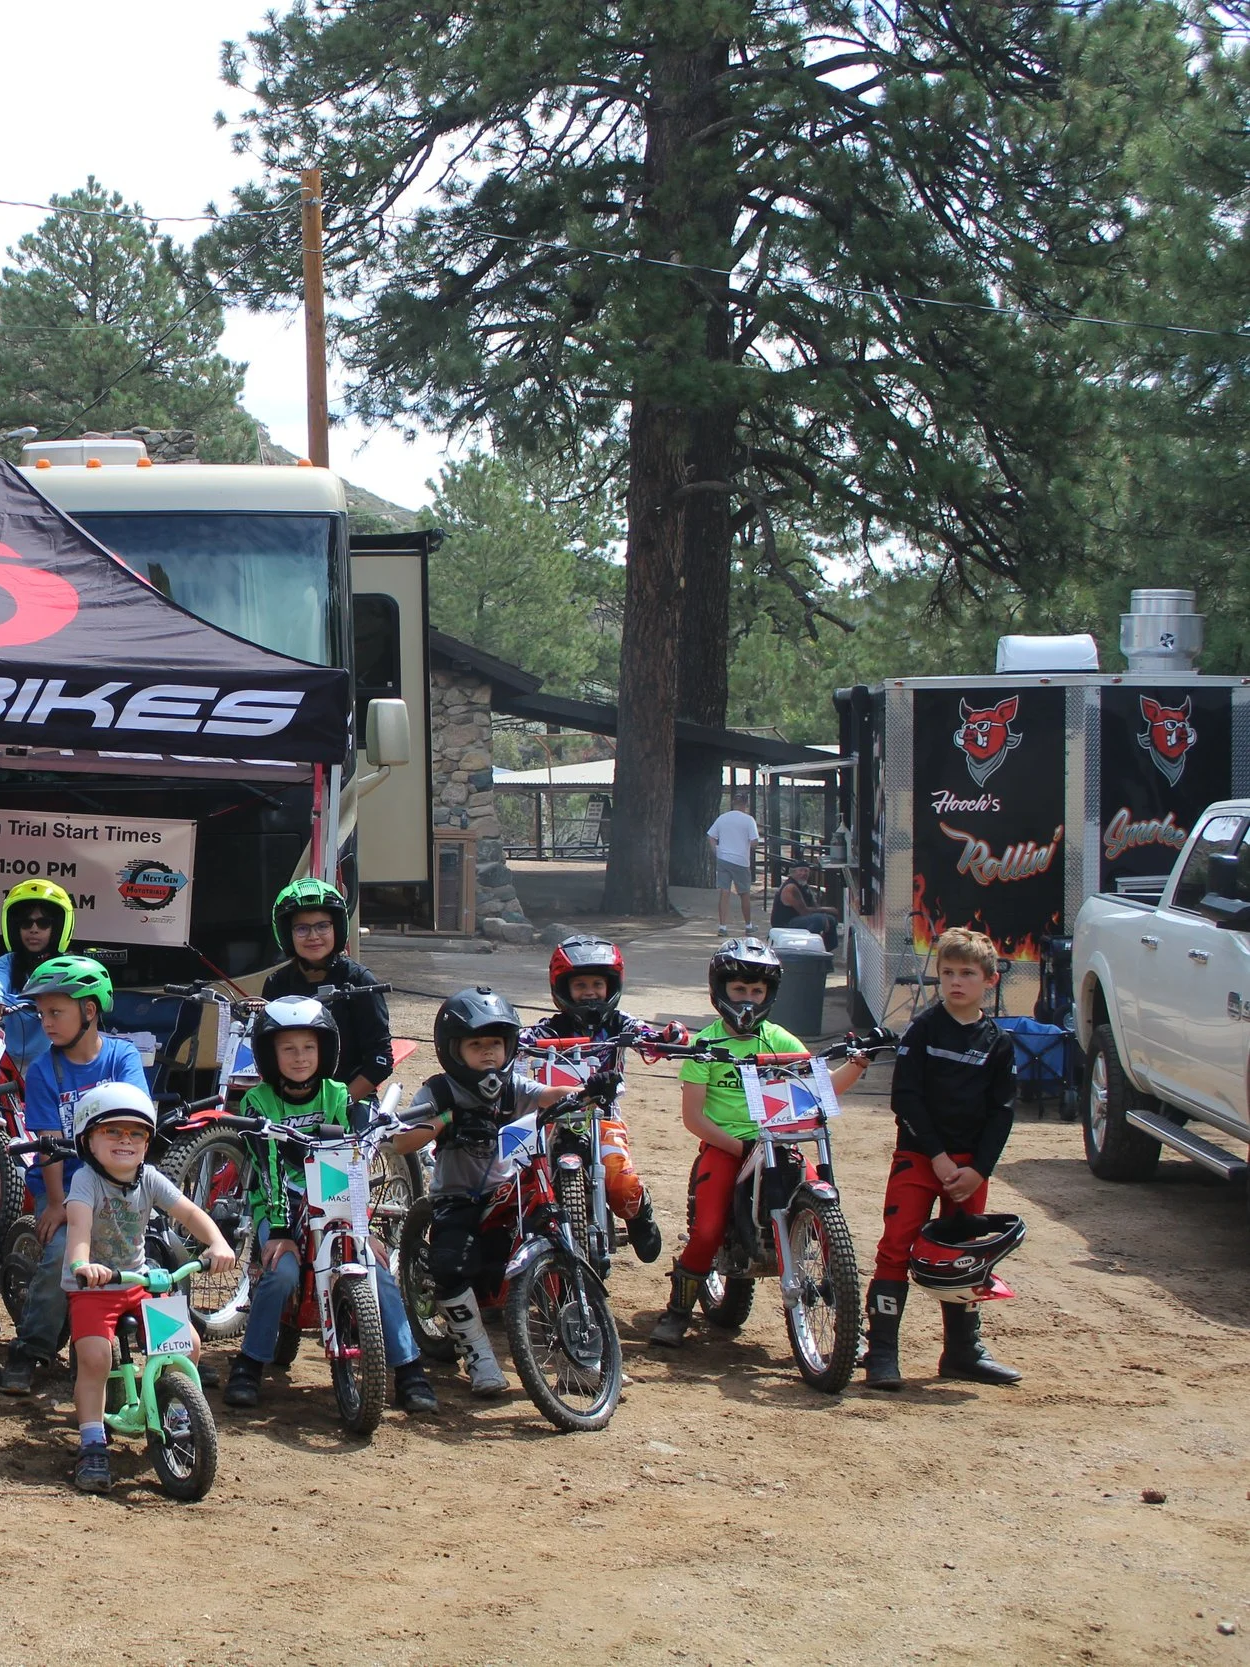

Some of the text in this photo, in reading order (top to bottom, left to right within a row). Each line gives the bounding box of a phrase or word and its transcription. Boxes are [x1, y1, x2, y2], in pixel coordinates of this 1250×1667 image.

[931, 789, 1001, 814] Hooch's
[7, 819, 47, 838] Trial
[52, 822, 99, 841] Start
[104, 825, 162, 844] Times
[939, 821, 1065, 887] Rollin'
[46, 861, 77, 878] PM
[156, 1339, 192, 1352] KELTON
